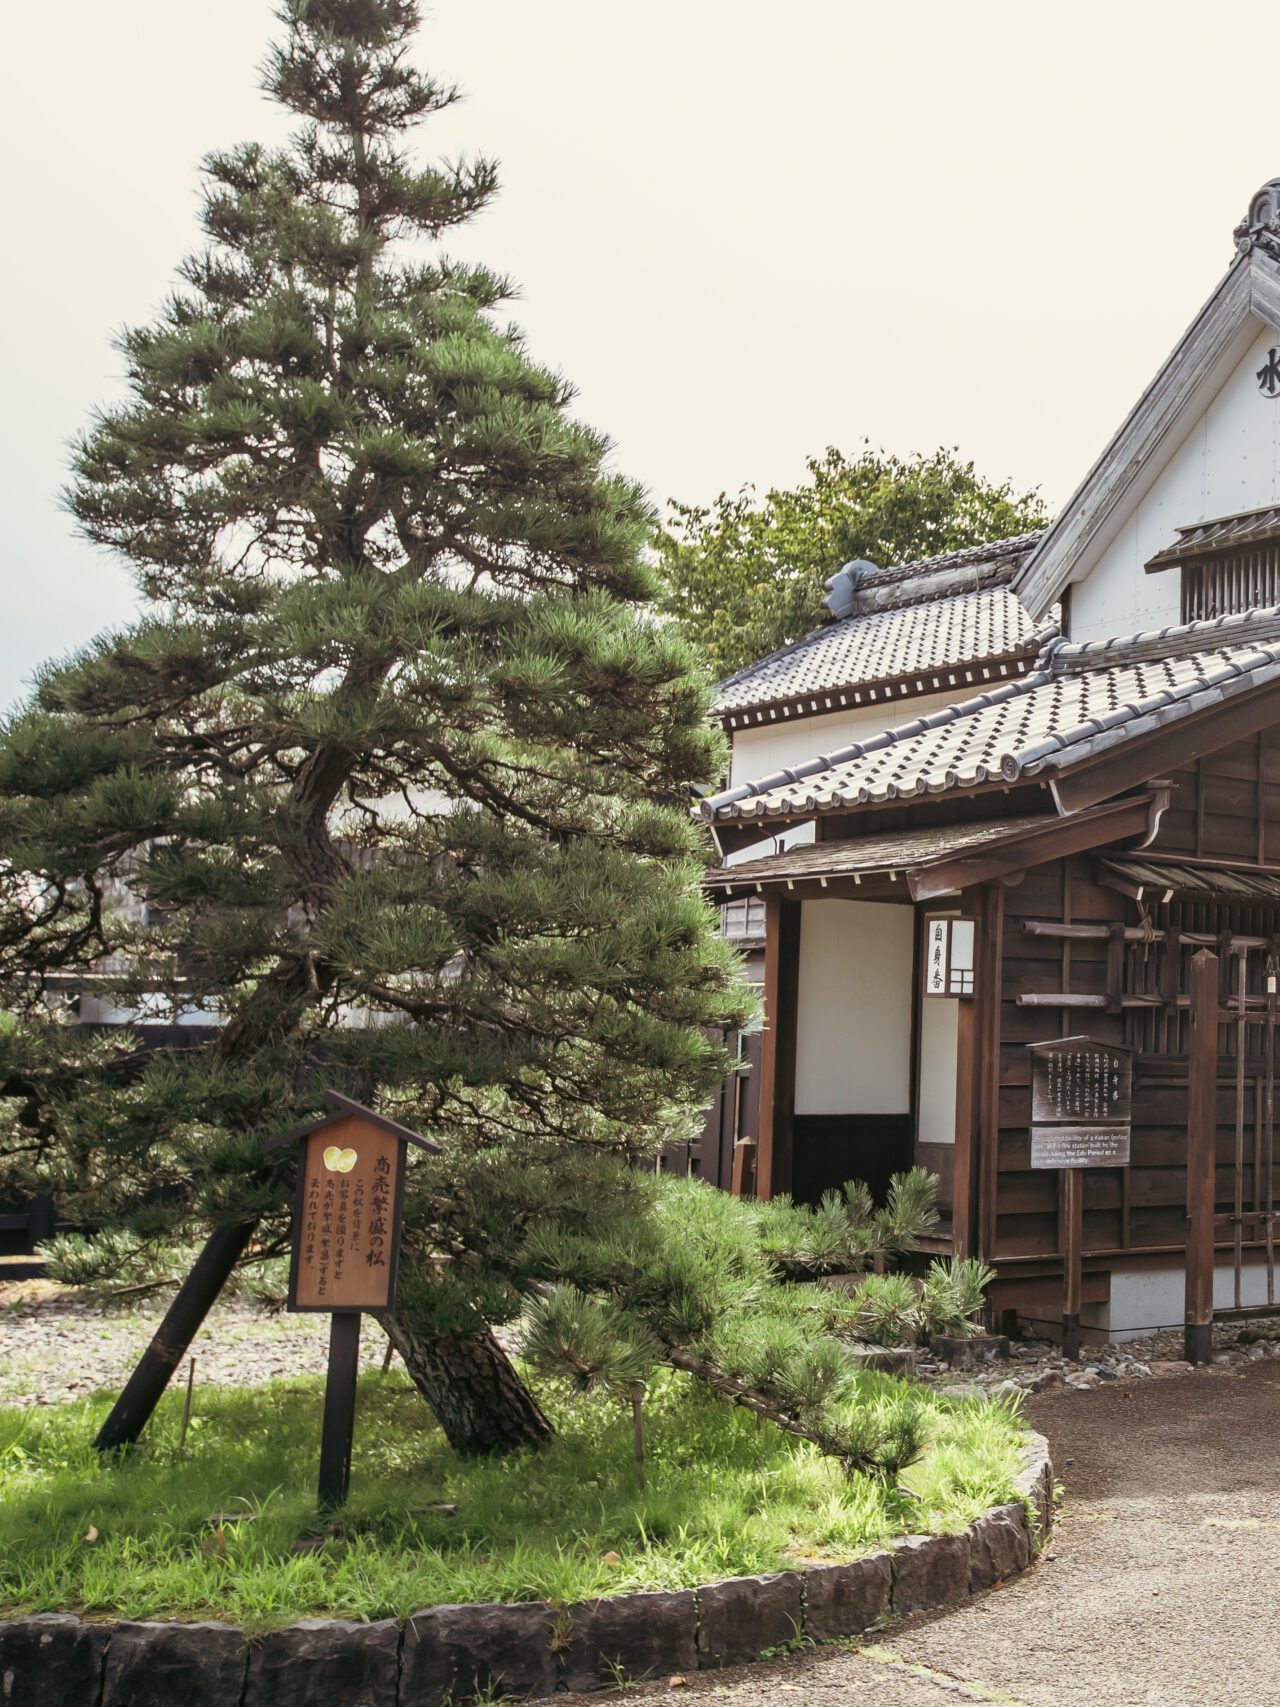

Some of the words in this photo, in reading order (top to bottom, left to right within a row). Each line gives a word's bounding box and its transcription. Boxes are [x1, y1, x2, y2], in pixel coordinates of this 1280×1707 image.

[932, 923, 943, 989] 自身番
[350, 1179, 364, 1252] この松を背景に
[366, 1155, 391, 1267] 商売繁盛の松
